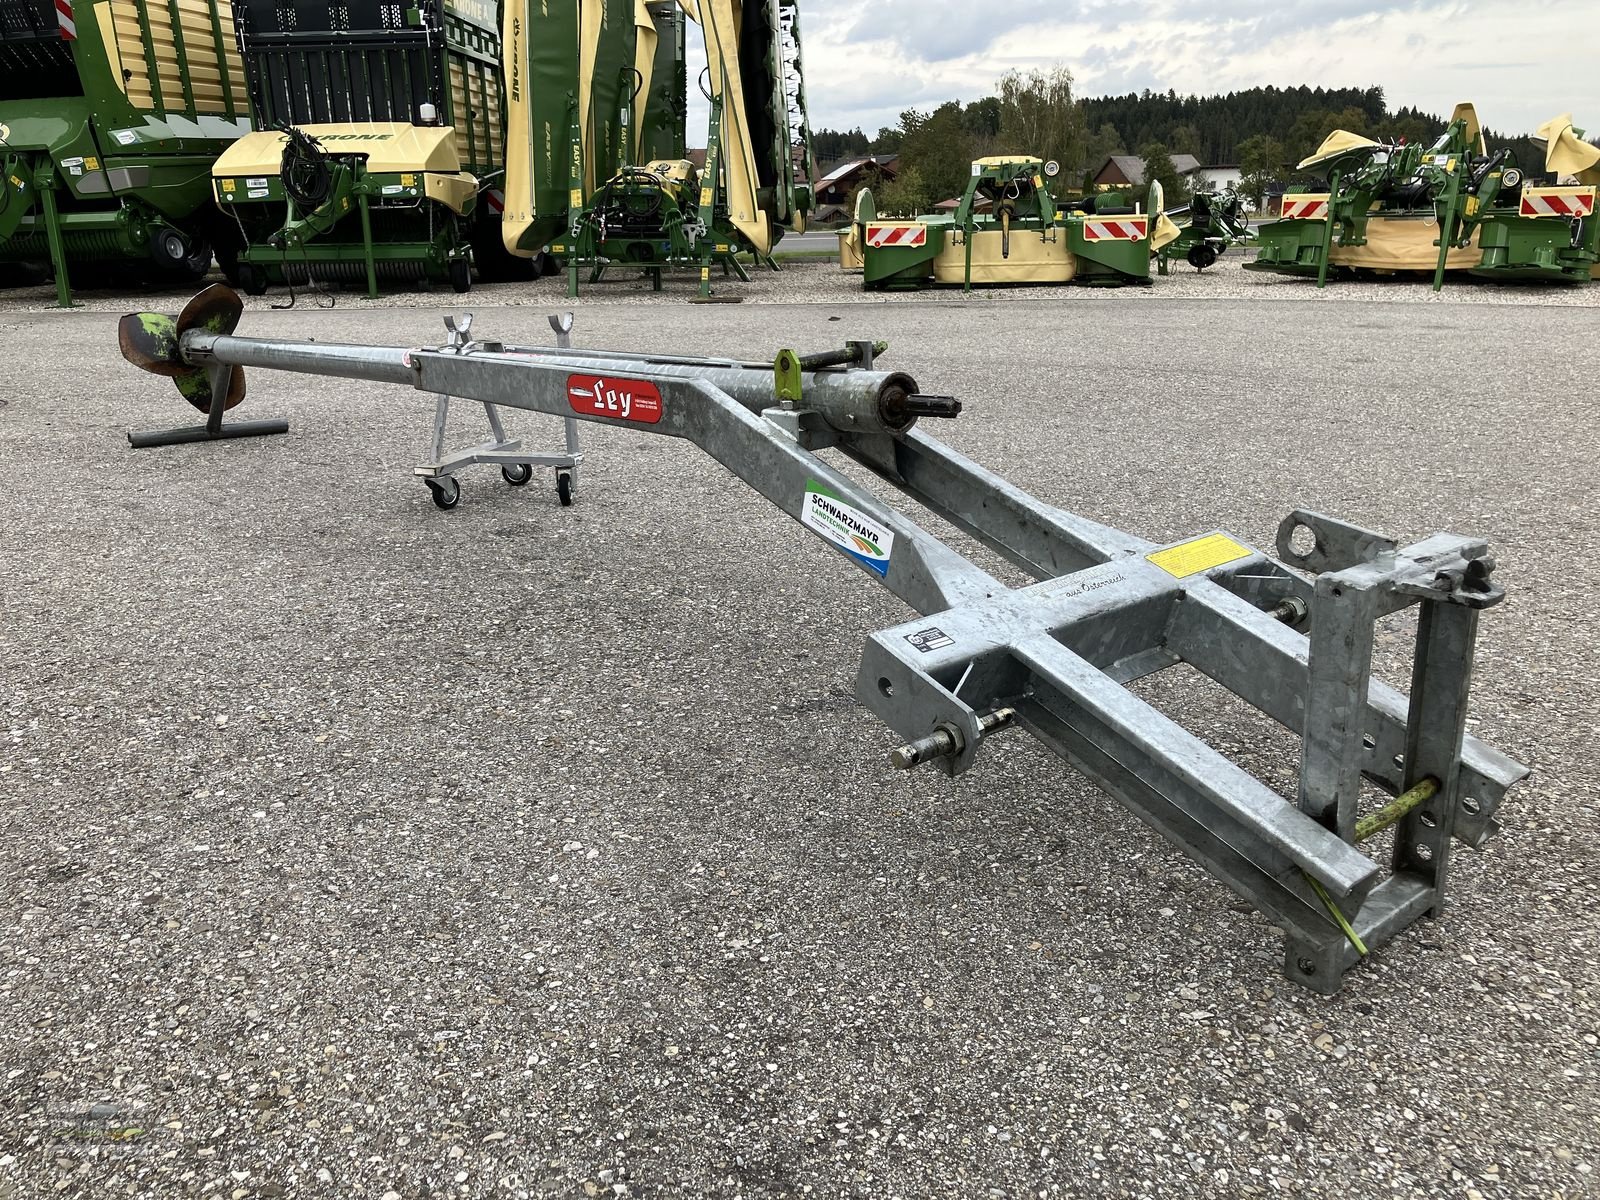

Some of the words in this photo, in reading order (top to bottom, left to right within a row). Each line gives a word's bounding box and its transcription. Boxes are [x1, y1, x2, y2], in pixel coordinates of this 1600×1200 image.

[513, 38, 521, 103] KRONE
[573, 144, 581, 166] EASY
[704, 157, 713, 179] EASY
[811, 494, 879, 545] SCHWARZMAYR
[811, 506, 850, 536] LANDTECHNIK
